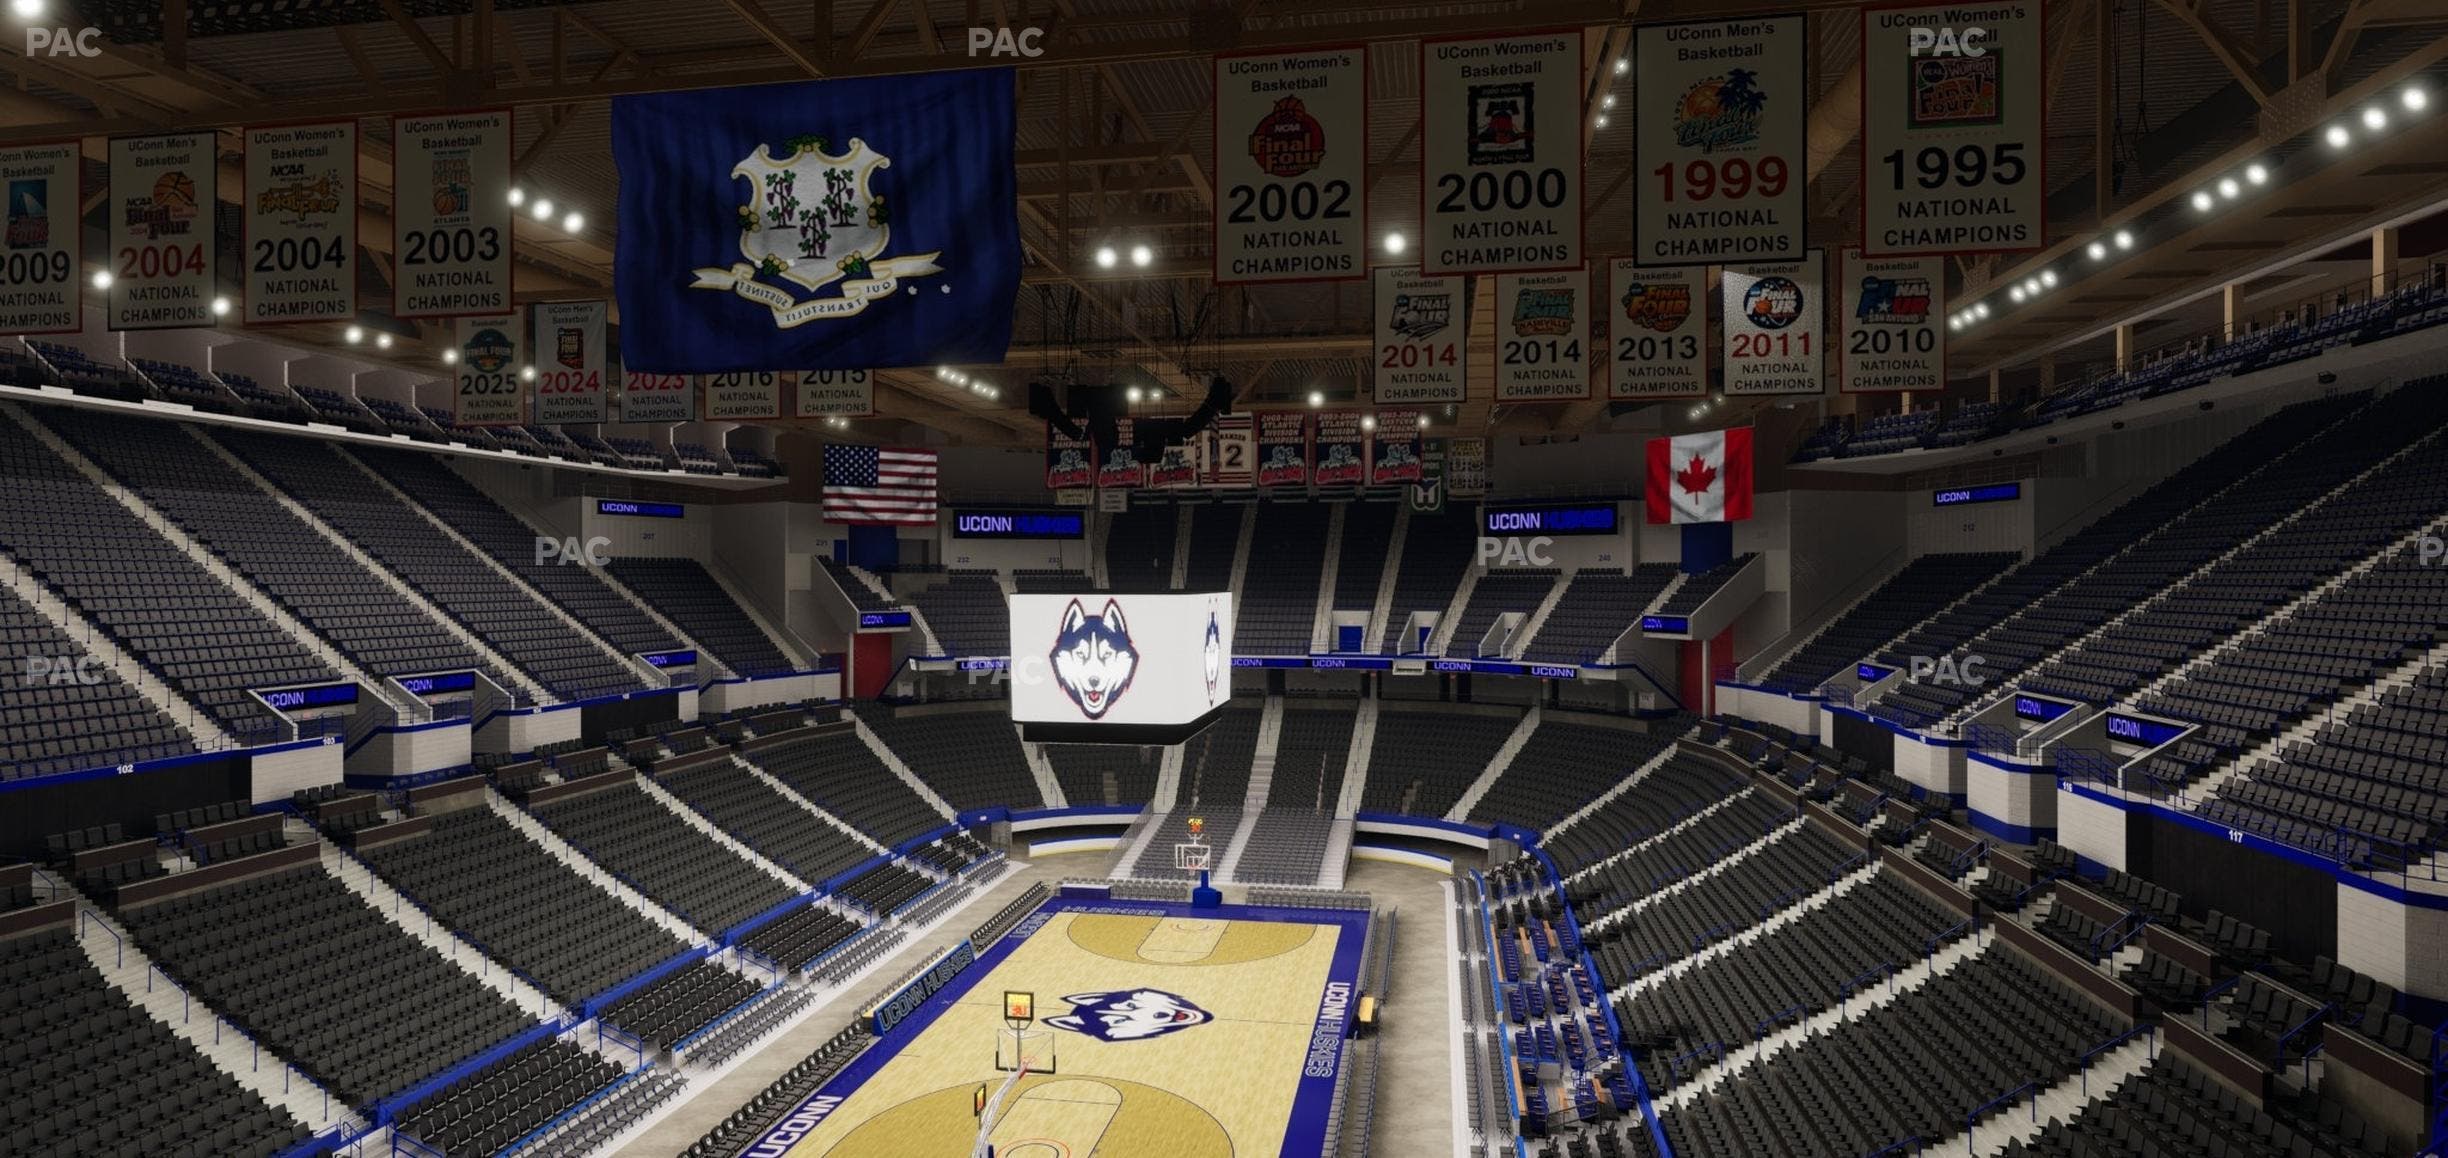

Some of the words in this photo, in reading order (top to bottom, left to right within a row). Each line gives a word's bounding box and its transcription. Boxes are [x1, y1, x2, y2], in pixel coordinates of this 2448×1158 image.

[1880, 12, 1938, 29] UConn
[1944, 5, 2025, 24] Women's
[1667, 27, 1722, 43] UConn
[1727, 22, 1775, 38] Men's
[1437, 45, 1490, 60] UConn
[1495, 39, 1567, 56] Women's
[1677, 43, 1763, 62] Basketball
[1229, 60, 1278, 74] UConn
[1282, 55, 1351, 70] Women's
[1461, 61, 1543, 79] Basketball
[1251, 76, 1328, 92] Basketball
[405, 121, 444, 134] UConn
[447, 116, 500, 131] Women's
[128, 139, 163, 151] UConn
[167, 136, 197, 148] Men's
[254, 132, 292, 144] UConn
[294, 128, 346, 142] Women's
[422, 135, 482, 150] Basketball
[24, 149, 70, 160] Women's
[135, 153, 190, 168] Basketball
[271, 146, 328, 160] Basketball
[3, 165, 55, 178] Basketball
[270, 164, 304, 177] NCAA
[1883, 143, 2027, 190] 1995
[1653, 156, 1788, 202] 1999
[1436, 168, 1567, 214] 2000
[1228, 180, 1351, 223] 2002
[1898, 197, 2016, 219] NATIONAL
[1667, 208, 1779, 231] NATIONAL
[1453, 220, 1558, 239] NATIONAL
[1884, 224, 2027, 247] CHAMPIONS
[405, 227, 500, 266] 2003
[1243, 230, 1343, 248] NATIONAL
[1654, 235, 1790, 257] CHAMPIONS
[119, 243, 206, 279] 2004
[254, 235, 346, 273] 2004
[1440, 245, 1568, 266] CHAMPIONS
[1232, 255, 1352, 274] CHAMPIONS
[1748, 264, 1800, 275] Basketball
[1866, 262, 1919, 272] Basketball
[416, 271, 494, 288] NATIONAL
[1397, 280, 1444, 289] Basketball
[1519, 275, 1567, 285] Basketball
[1633, 272, 1683, 281] Basketball
[129, 286, 199, 302] NATIONAL
[265, 279, 339, 295] NATIONAL
[1761, 288, 1797, 300] FINAL
[257, 300, 346, 317] CHAMPIONS
[408, 293, 501, 310] CHAMPIONS
[1409, 296, 1449, 310] FINAL
[0, 312, 71, 327] HAMPIONS
[121, 306, 207, 323] CHAMPIONS
[1618, 335, 1697, 362] 2013
[1732, 332, 1810, 358] 2011
[1850, 328, 1934, 354] 2010
[1382, 343, 1457, 368] 2014
[1504, 339, 1581, 365] 2014
[1628, 366, 1692, 377] NATIONAL
[1742, 363, 1808, 374] NATIONAL
[1861, 360, 1928, 371] NATIONAL
[540, 371, 600, 394] 2024
[627, 371, 685, 391] 2023
[1391, 373, 1451, 384] NATIONAL
[1513, 369, 1576, 380] NATIONAL
[1853, 375, 1936, 388] CHAMPIONS
[460, 374, 517, 395] 2025
[1506, 384, 1582, 396] CHAMPIONS
[1620, 381, 1698, 393] CHAMPIONS
[1735, 378, 1815, 390] CHAMPIONS
[632, 395, 681, 405] NATIONAL
[719, 391, 769, 401] NATIONAL
[811, 388, 862, 399] NATIONAL
[1384, 387, 1458, 399] CHAMPIONS
[468, 399, 515, 409] NATIONAL
[546, 397, 593, 407] NATIONAL
[713, 404, 774, 416] CHAMPIONS
[805, 402, 867, 413] CHAMPIONS
[462, 412, 519, 422] CHAMPIONS
[542, 410, 599, 420] CHAMPIONS
[628, 408, 686, 419] CHAMPIONS
[1937, 490, 1970, 503] UCONN
[601, 503, 638, 513] UCONN
[959, 516, 1013, 532] UCONN
[1489, 512, 1541, 530] UCONN
[1312, 659, 1345, 668] UCONN
[1434, 662, 1471, 671] UCONN
[1531, 666, 1574, 678] UCONN
[2016, 699, 2041, 715] UCONN
[2108, 717, 2140, 738] UCONN
[117, 764, 134, 775] 102
[2229, 830, 2243, 843] 117
[880, 982, 926, 1031] UCONN
[923, 944, 972, 996] HUSKIES
[1320, 982, 1351, 1020] UCONN
[1305, 1020, 1342, 1078] HUSKIES
[747, 1095, 844, 1158] UCONN
